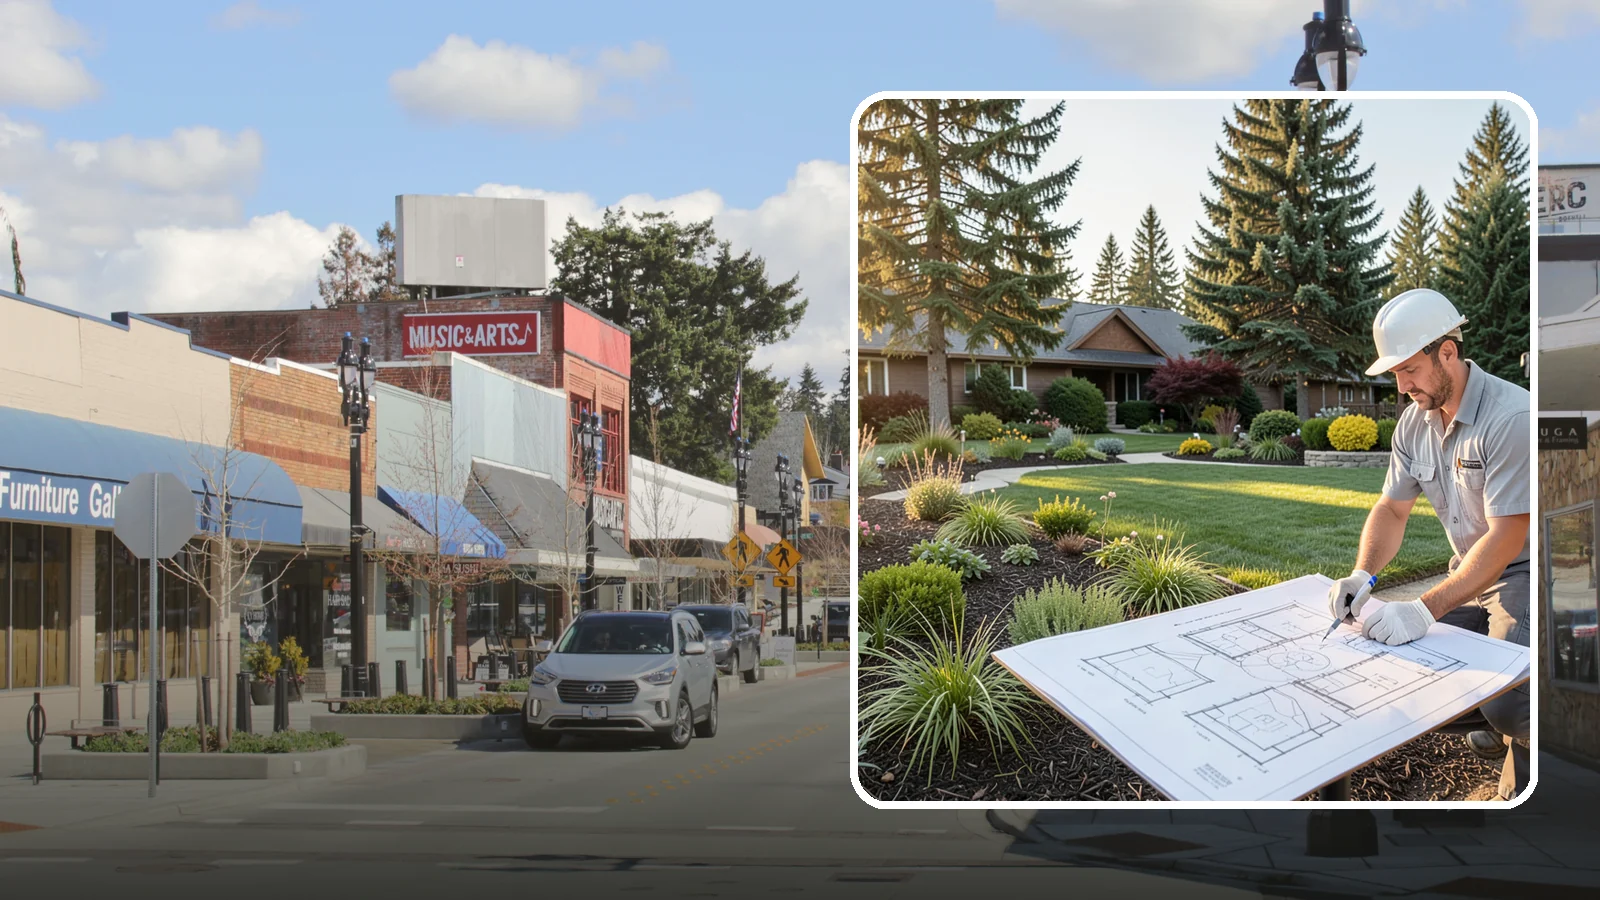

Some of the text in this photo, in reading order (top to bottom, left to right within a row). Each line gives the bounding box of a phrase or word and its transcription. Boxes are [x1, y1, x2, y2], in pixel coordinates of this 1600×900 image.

[1538, 181, 1587, 213] ERC
[408, 323, 519, 349] MUSIC&ARTS
[1540, 427, 1578, 437] UGA
[0, 471, 121, 519] Furniture Gal
